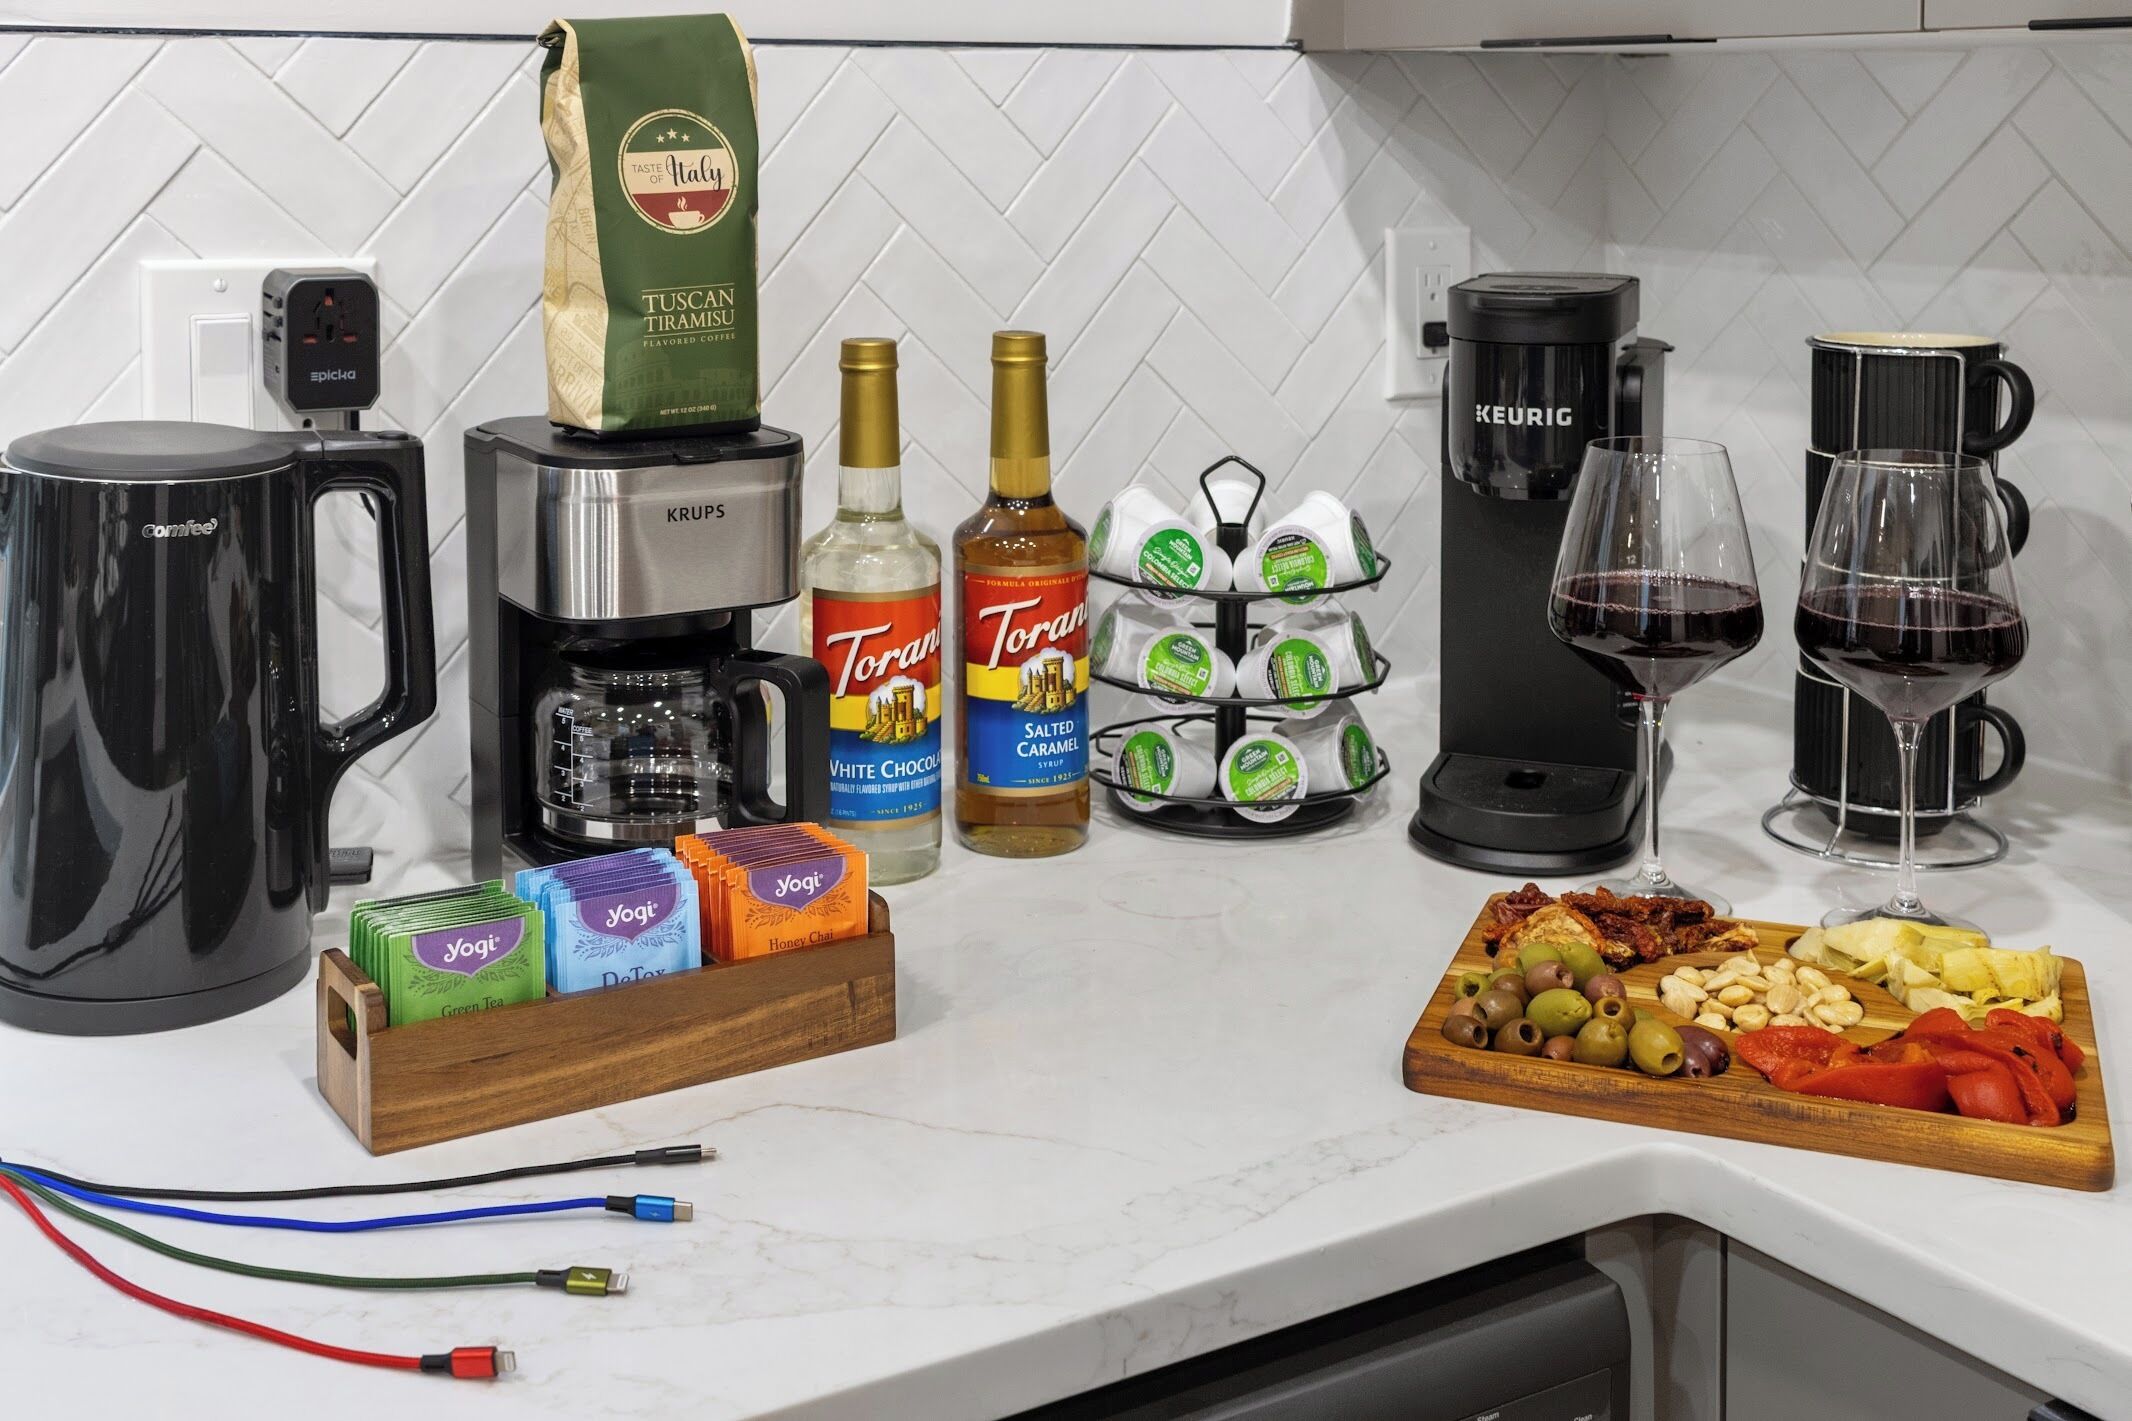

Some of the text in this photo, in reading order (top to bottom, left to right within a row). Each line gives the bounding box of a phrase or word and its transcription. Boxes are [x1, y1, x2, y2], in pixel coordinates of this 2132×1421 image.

[632, 163, 662, 173] TASTE
[665, 154, 725, 192] Italy
[650, 175, 664, 184] OF
[642, 288, 735, 313] TUSCAN
[644, 309, 735, 332] TIRAMISU
[644, 332, 736, 347] FLAVORED COFFEE
[1476, 404, 1572, 427] KEURIG
[667, 504, 726, 523] KRUPS
[1173, 537, 1193, 553] GREEN
[1141, 549, 1172, 576] COLOMBIA
[986, 579, 1025, 588] FORMULA
[1028, 577, 1070, 587] ORIGINALE
[979, 586, 1088, 671] Torani
[1170, 644, 1200, 661] MOUNTAIN
[1176, 640, 1197, 653] GREEN
[1307, 655, 1319, 688] MOUNTAIN
[1314, 658, 1323, 681] GREEN
[558, 706, 574, 716] WATER
[573, 725, 593, 734] COFFEE
[1025, 720, 1074, 739] SALTED
[1017, 737, 1079, 758] CARAMEL
[1240, 748, 1261, 763] GREEN
[880, 751, 941, 779] CHOCOLA
[1038, 759, 1064, 769] SYRUP
[1239, 750, 1269, 770] MOUNTAIN
[1028, 772, 1072, 785] SINCE 1925
[877, 802, 923, 815] SINCE 1925
[768, 929, 834, 951] Honey Chai
[442, 996, 504, 1017] Green Tea
